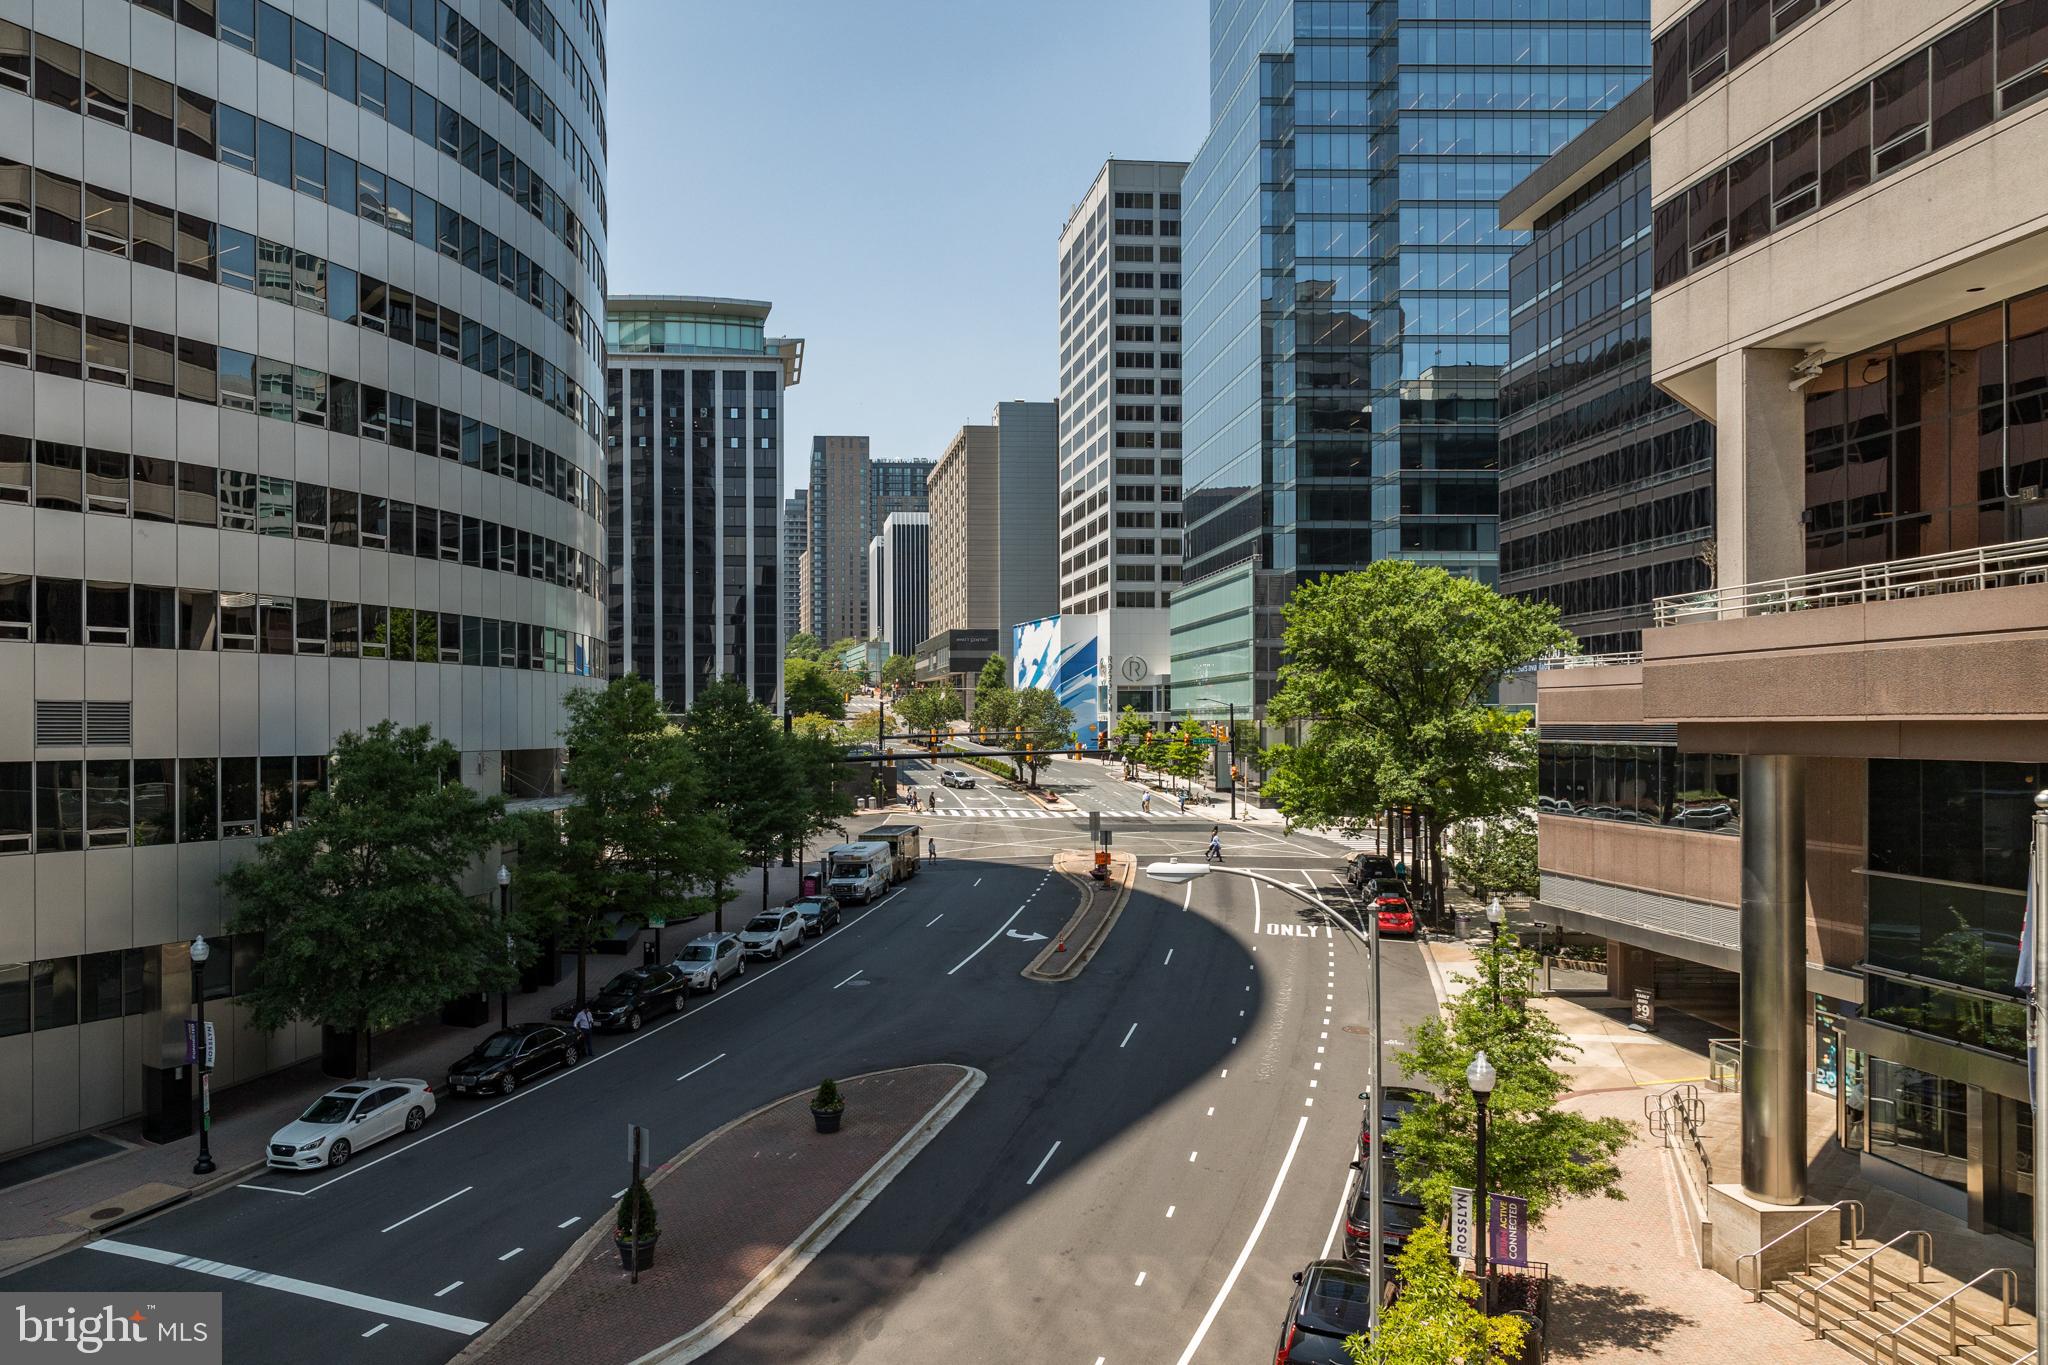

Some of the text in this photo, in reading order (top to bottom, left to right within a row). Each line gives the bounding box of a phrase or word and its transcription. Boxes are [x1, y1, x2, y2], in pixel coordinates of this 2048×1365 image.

[1267, 923, 1319, 937] ONLY
[1636, 1004, 1650, 1017] $9
[1456, 1193, 1468, 1253] ROSSLYN
[1500, 1200, 1508, 1229] ACTIVE
[1509, 1203, 1518, 1260] CONNECTED
